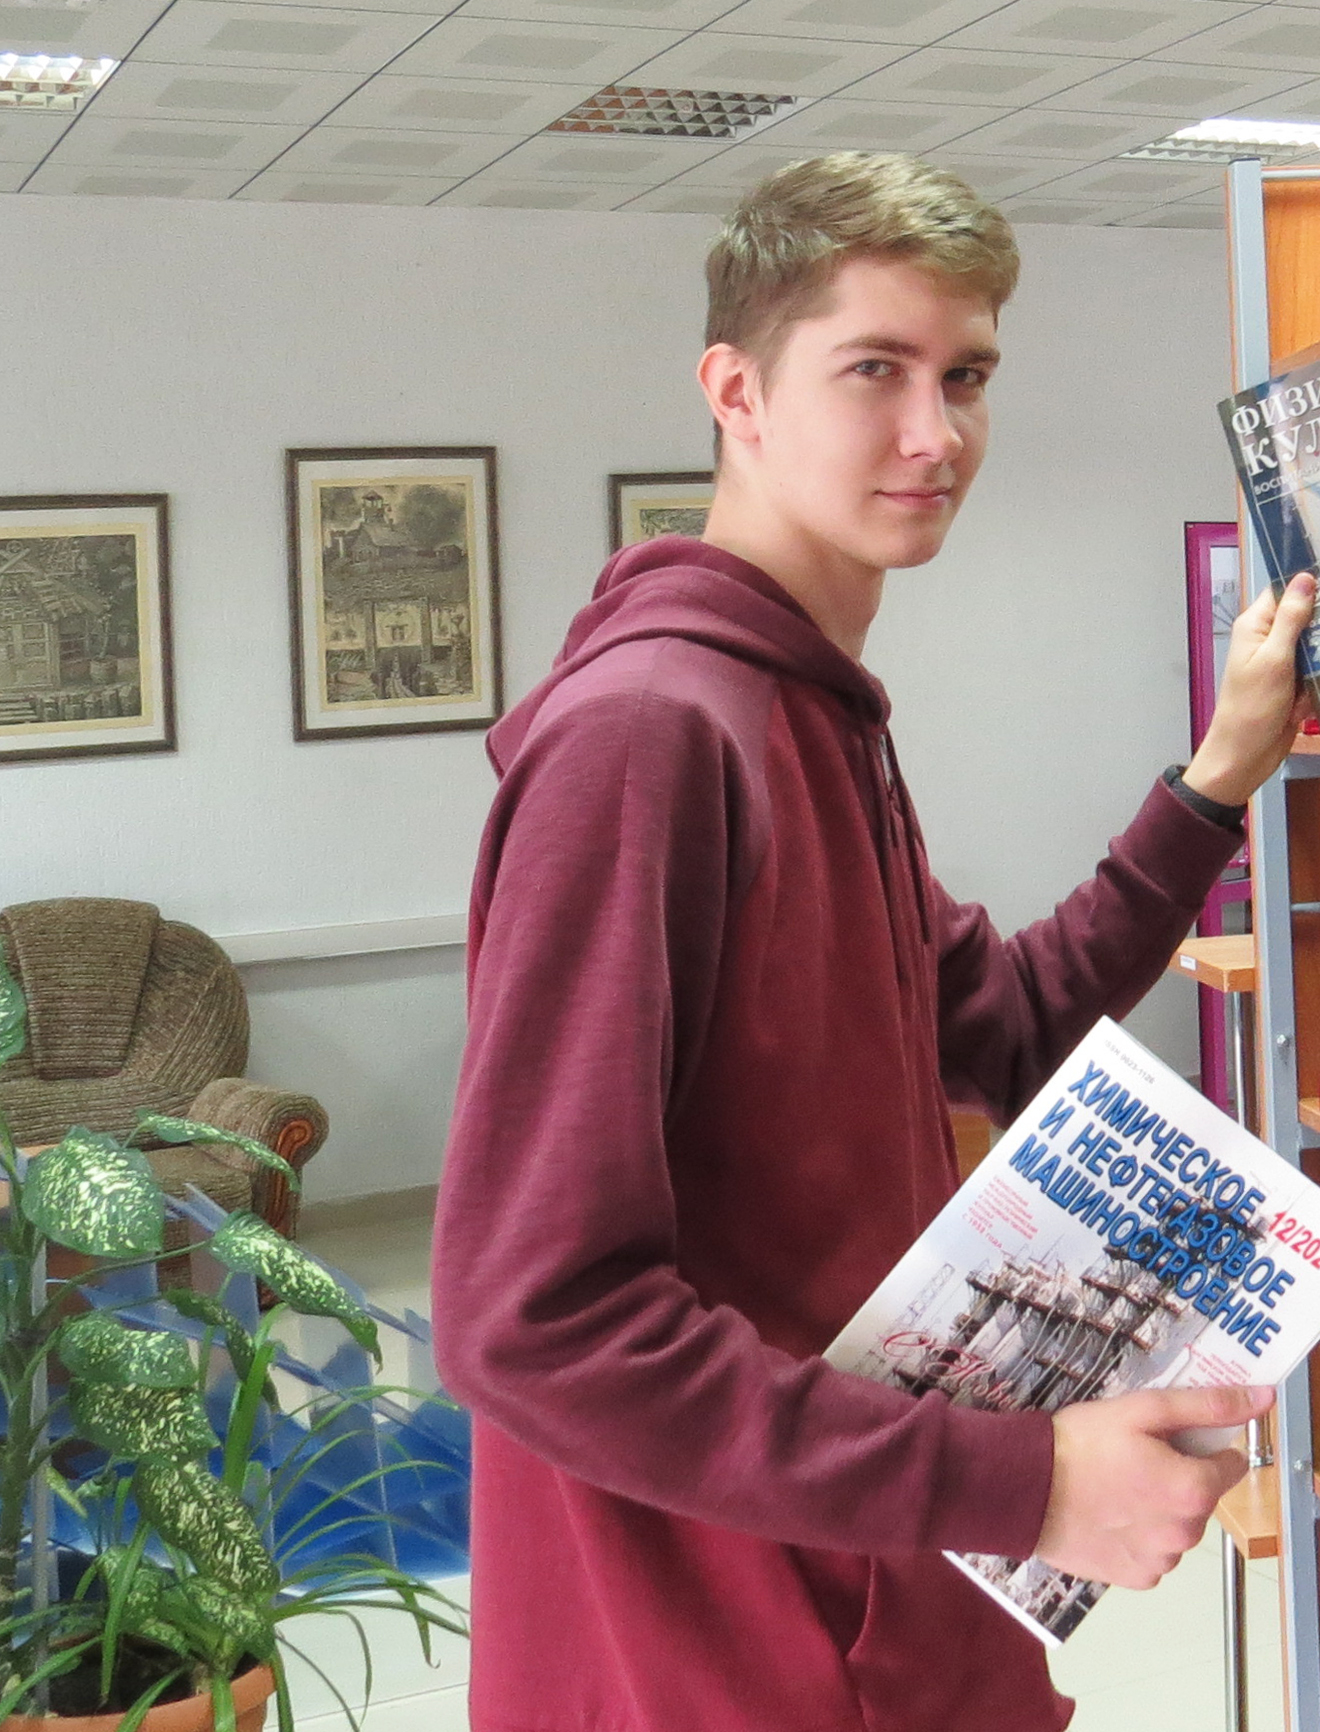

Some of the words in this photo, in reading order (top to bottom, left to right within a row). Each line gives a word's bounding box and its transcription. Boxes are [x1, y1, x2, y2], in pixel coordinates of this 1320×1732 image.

[1009, 1134, 1281, 1358] МАШИНОСТРОЕНИЕ
[1039, 1097, 1075, 1139] И
[1067, 1122, 1294, 1309] НЕФТЕГАЗОВОЕ
[1068, 1060, 1266, 1224] ХИМИЧЕСКОЕ
